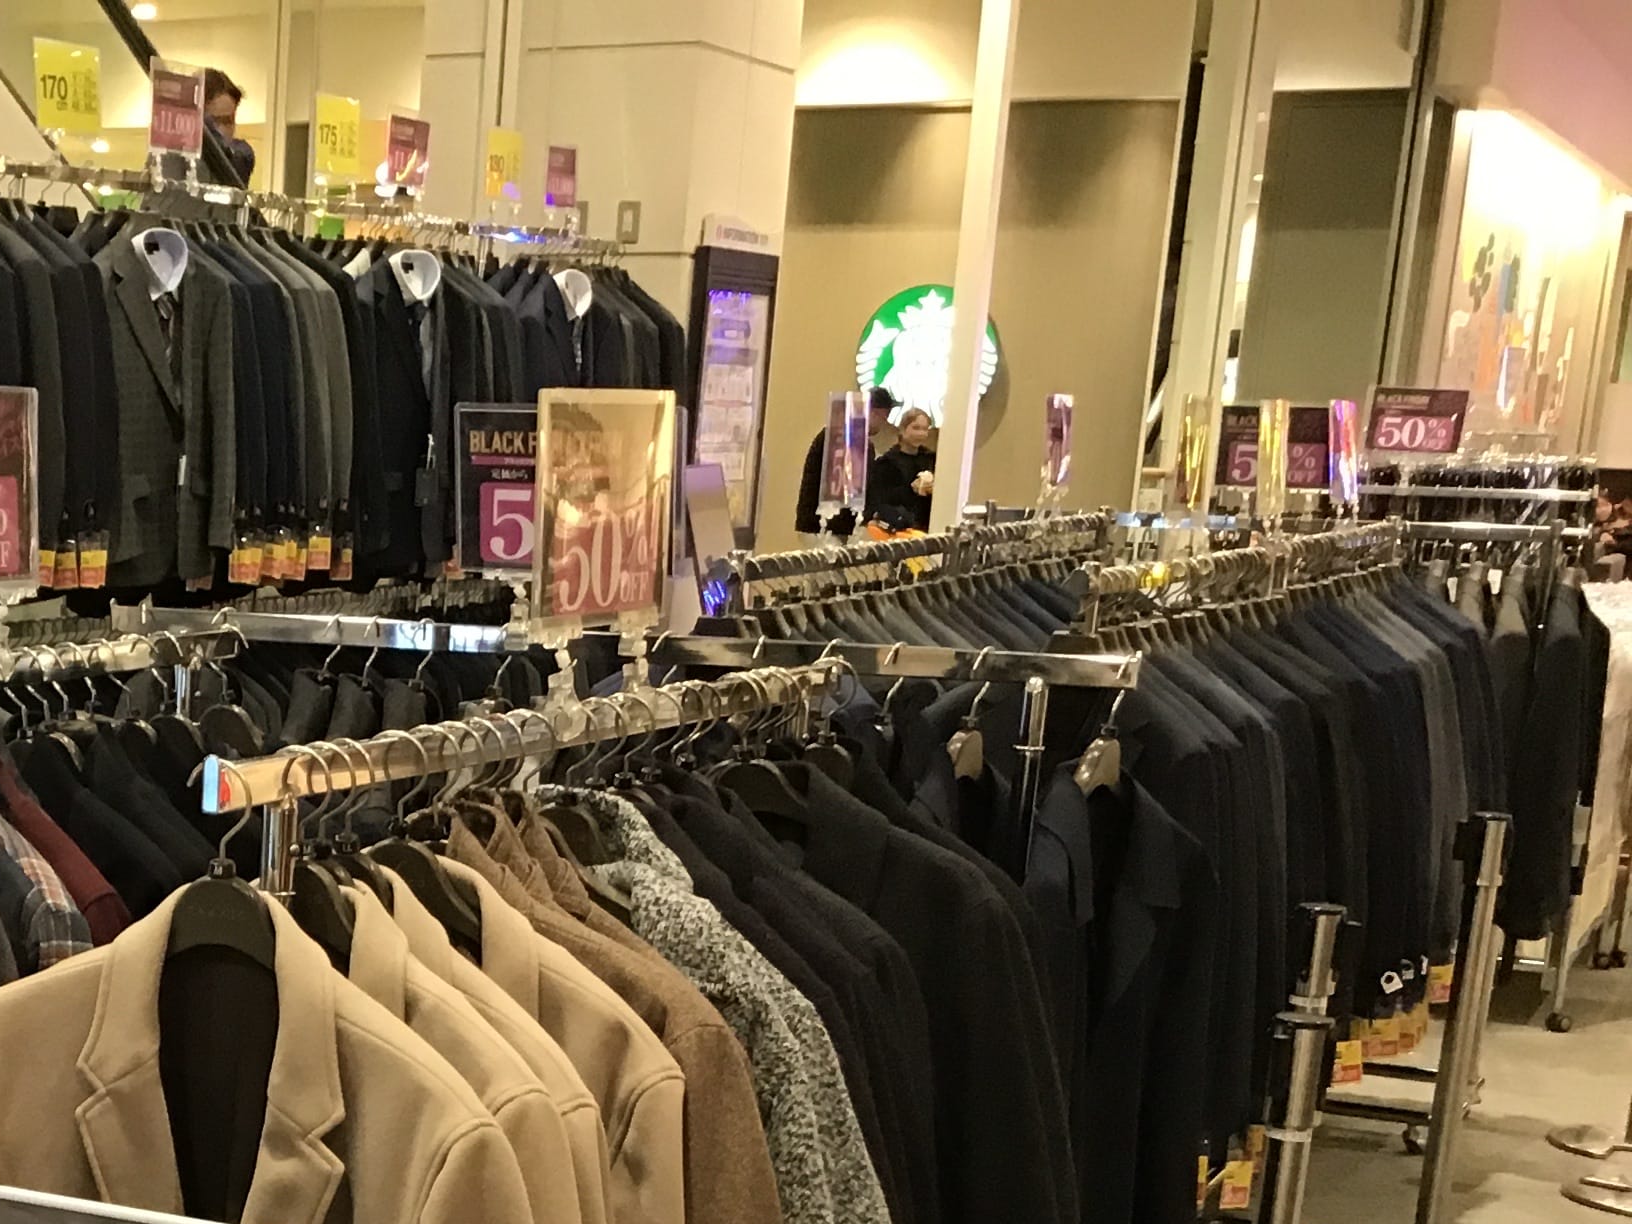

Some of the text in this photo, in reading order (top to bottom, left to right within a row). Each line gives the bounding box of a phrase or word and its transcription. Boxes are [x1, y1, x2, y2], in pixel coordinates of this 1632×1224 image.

[39, 74, 69, 102] 170
[318, 124, 339, 147] 175
[469, 429, 524, 454] BLACK
[489, 488, 535, 561] 5
